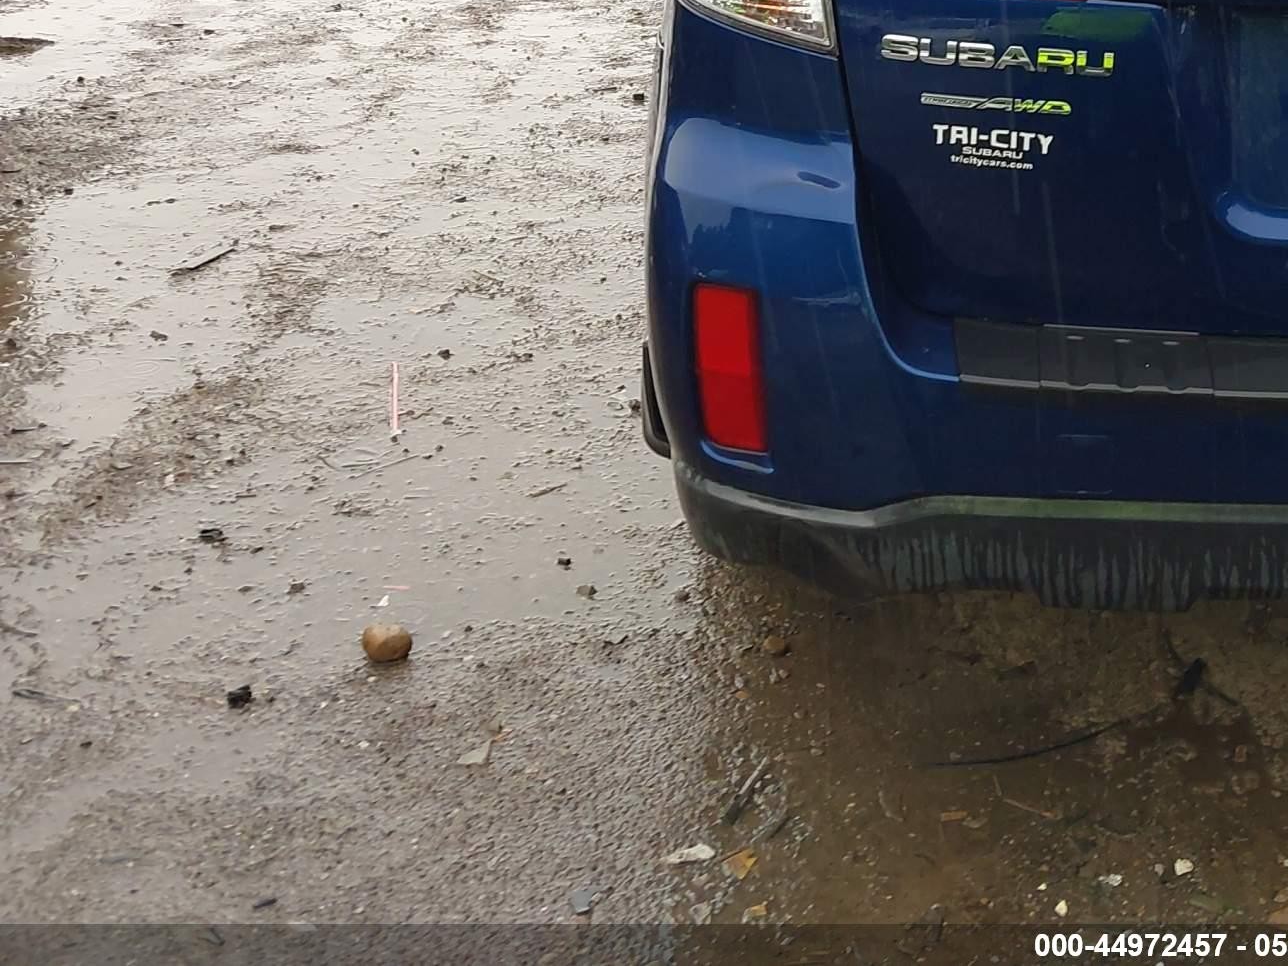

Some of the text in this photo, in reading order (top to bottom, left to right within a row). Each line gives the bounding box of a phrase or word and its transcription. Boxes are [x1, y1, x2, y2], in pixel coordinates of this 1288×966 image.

[881, 34, 1115, 77] SUBARU
[976, 97, 1072, 115] AWD
[933, 124, 1054, 155] TRI-CITY
[950, 154, 1034, 170] tricitycars.com
[962, 146, 1024, 160] SUBARU
